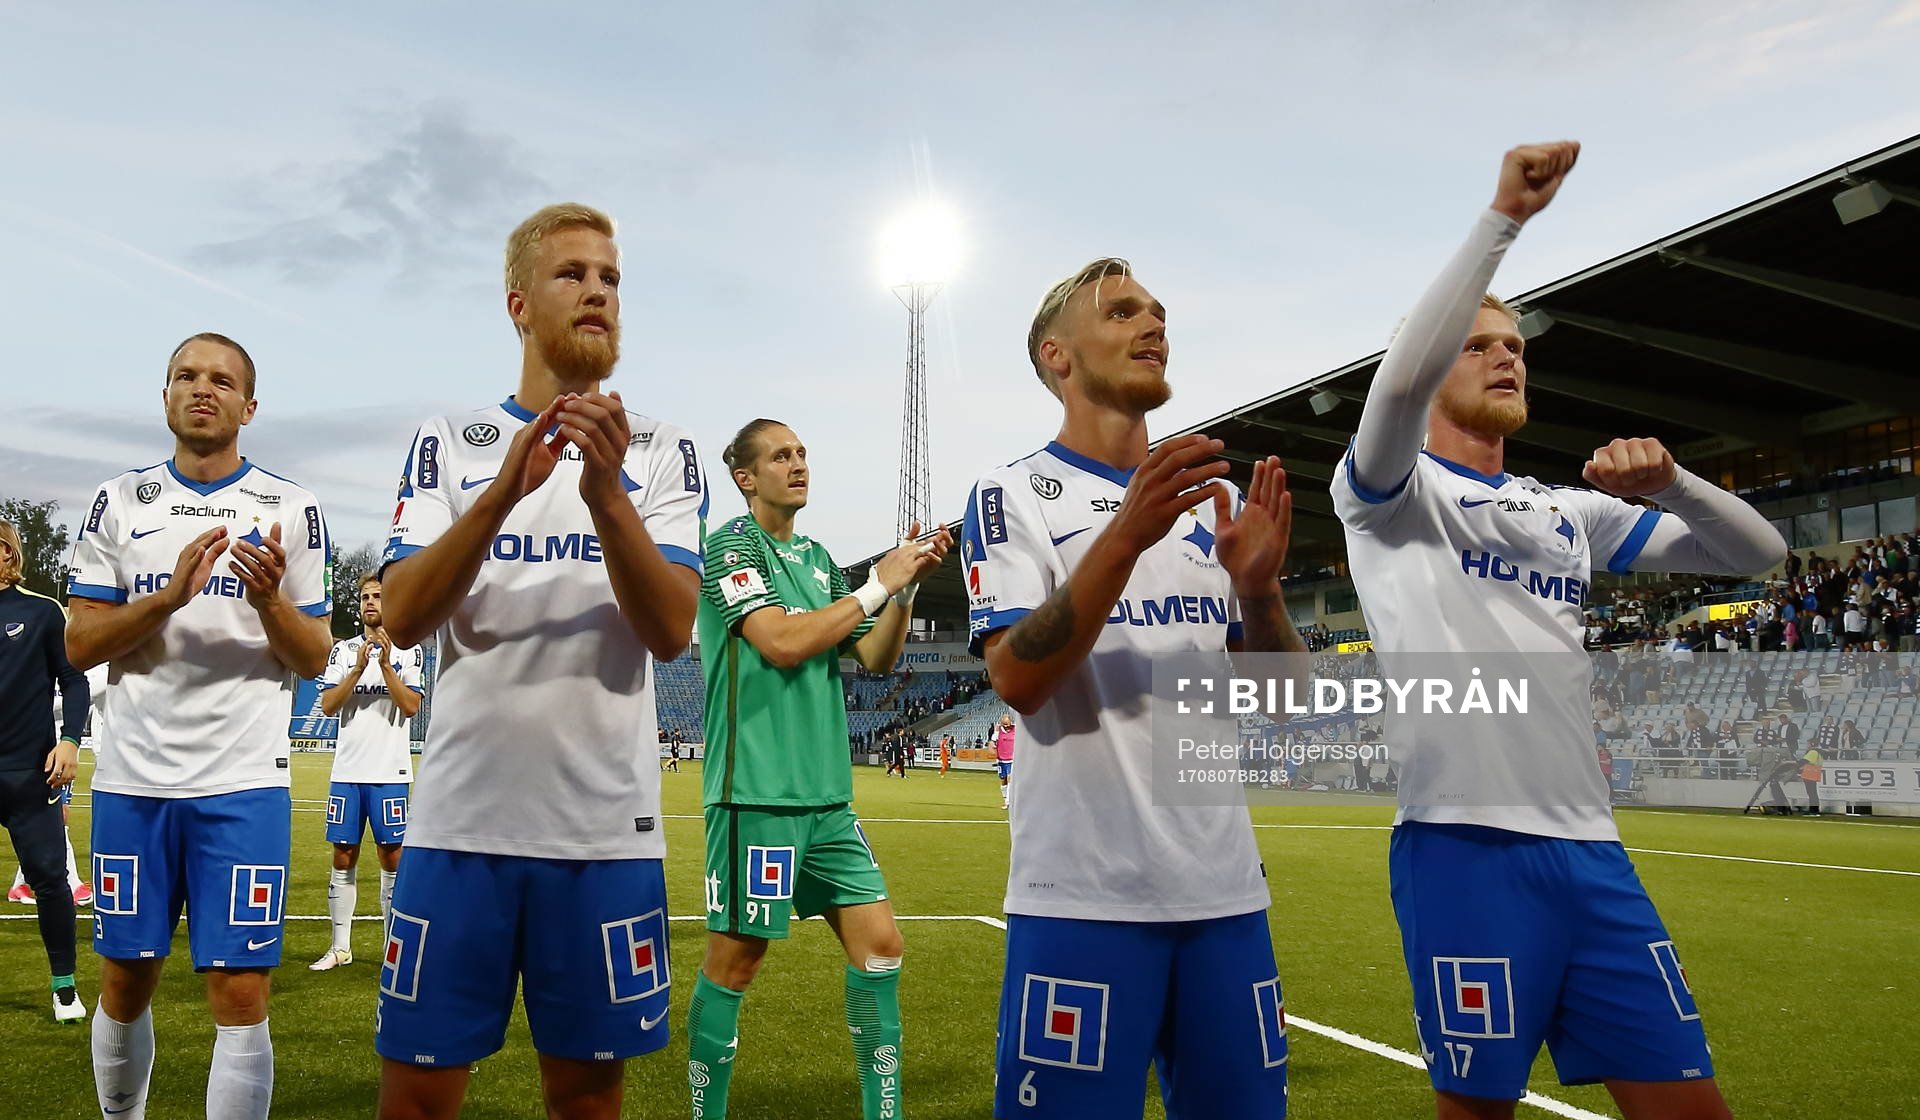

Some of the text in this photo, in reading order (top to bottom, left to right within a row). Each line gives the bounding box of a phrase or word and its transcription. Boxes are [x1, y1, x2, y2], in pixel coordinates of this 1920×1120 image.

[170, 504, 236, 519] stadium
[485, 533, 603, 563] OLME
[976, 595, 998, 606] SPEL
[1106, 595, 1228, 627] OLMEN
[1820, 769, 1896, 787] 1893
[746, 901, 771, 926] 91
[1444, 1042, 1473, 1078] 17
[1018, 1070, 1037, 1107] 6
